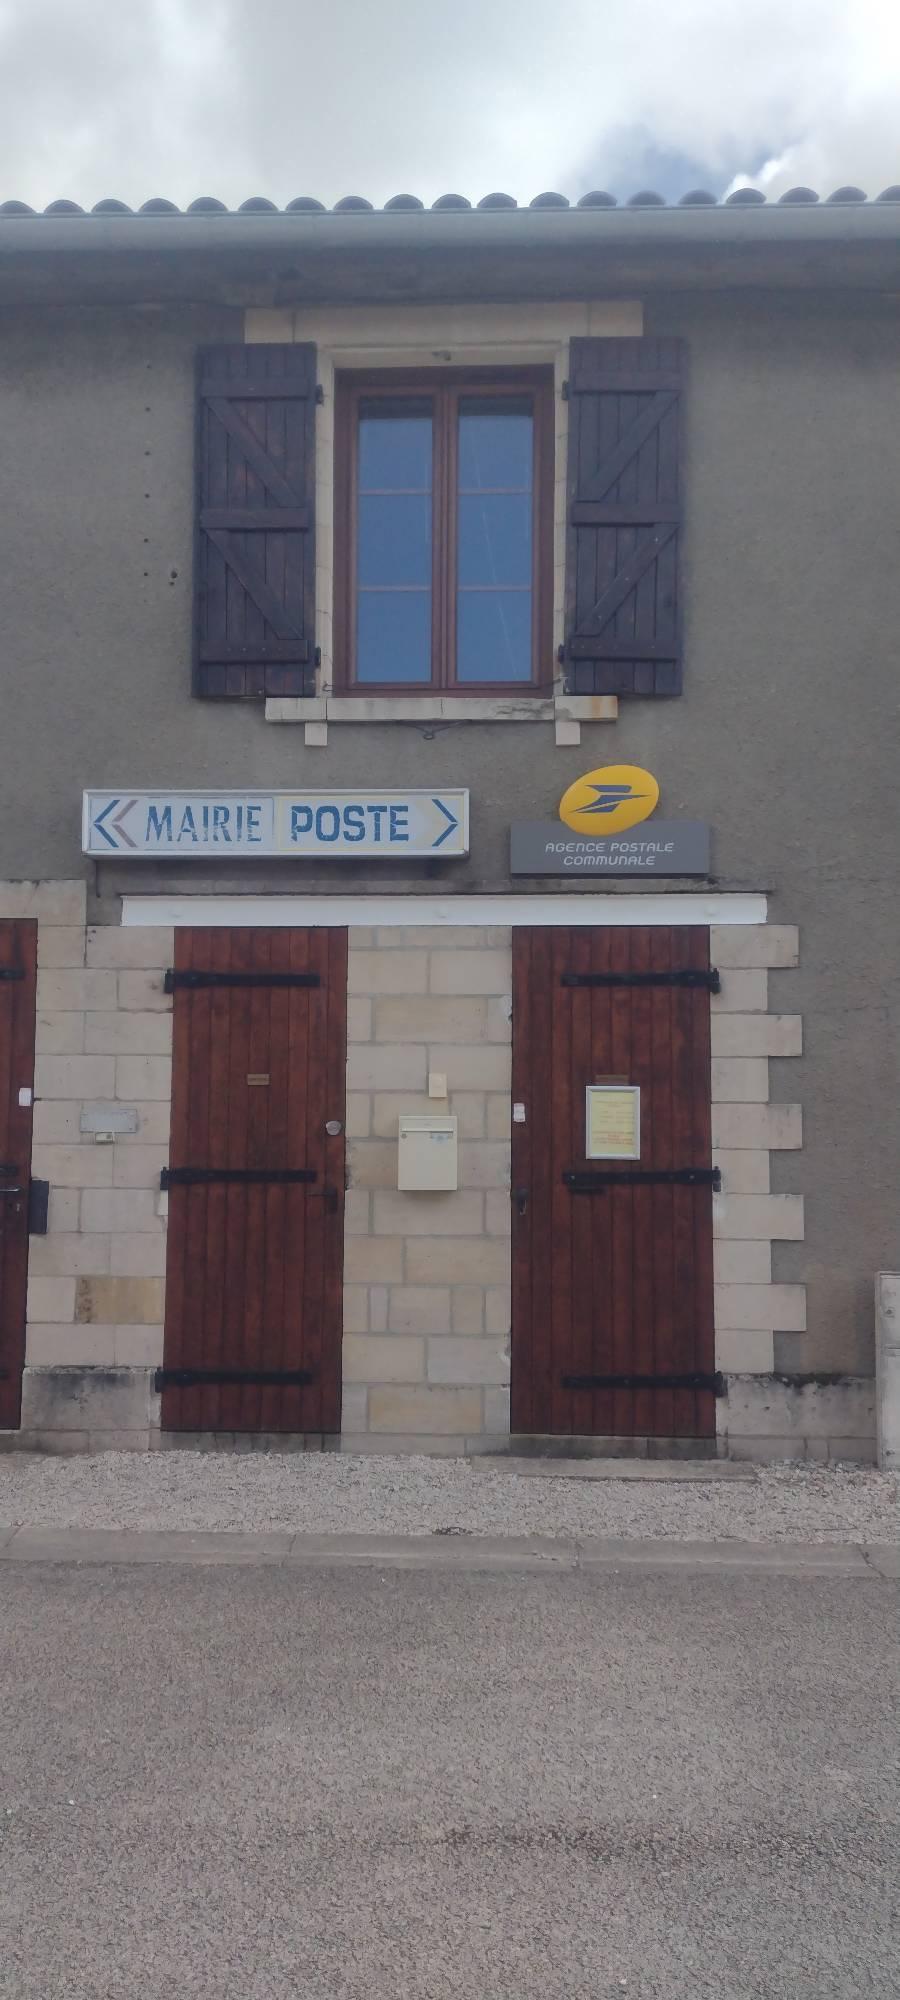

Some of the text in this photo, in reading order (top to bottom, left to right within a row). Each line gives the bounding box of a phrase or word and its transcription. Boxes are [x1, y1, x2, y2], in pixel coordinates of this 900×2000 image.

[145, 805, 410, 842] MAIRIE POSTE
[545, 842, 674, 853] AGENCE POSTALE
[563, 855, 656, 866] COMMUNALE
